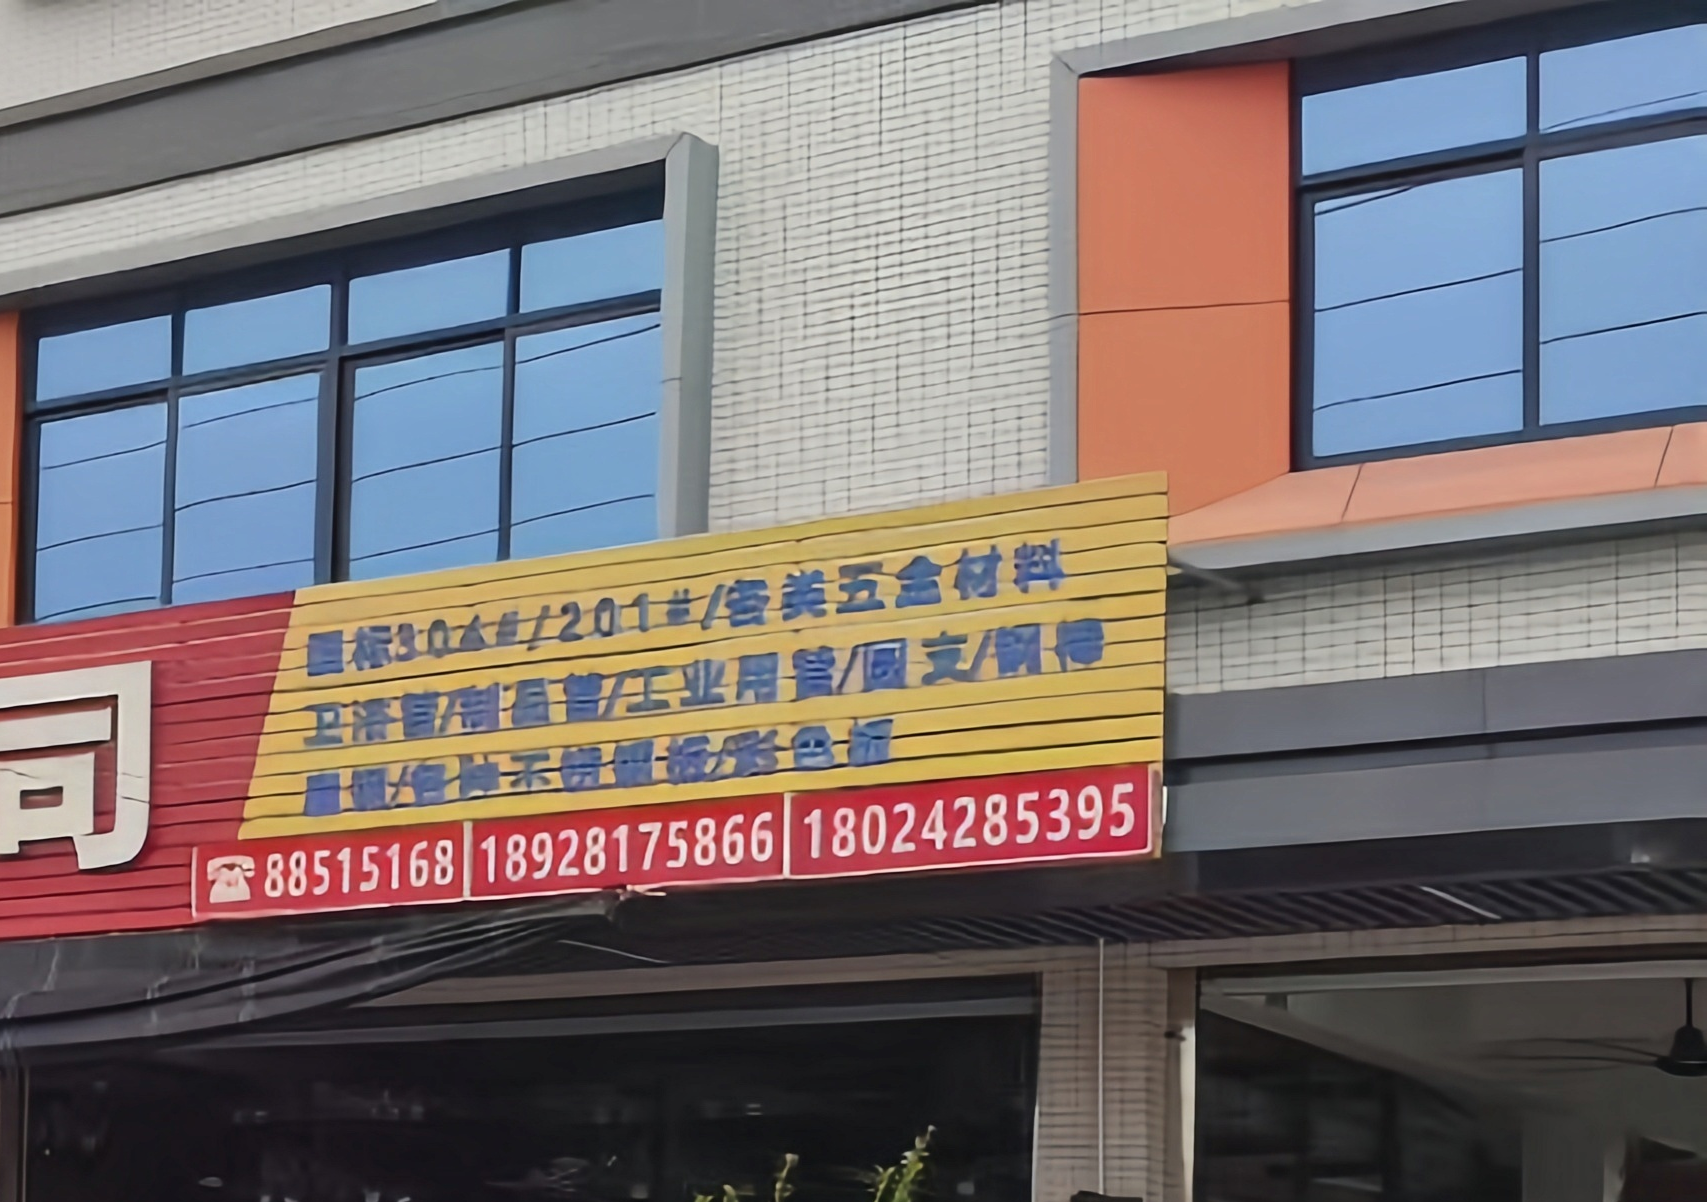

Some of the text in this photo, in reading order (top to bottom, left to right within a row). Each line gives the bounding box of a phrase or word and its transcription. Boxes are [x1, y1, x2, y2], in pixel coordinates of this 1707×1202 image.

[264, 782, 1135, 898] 88515168 18928175866 18024285395
